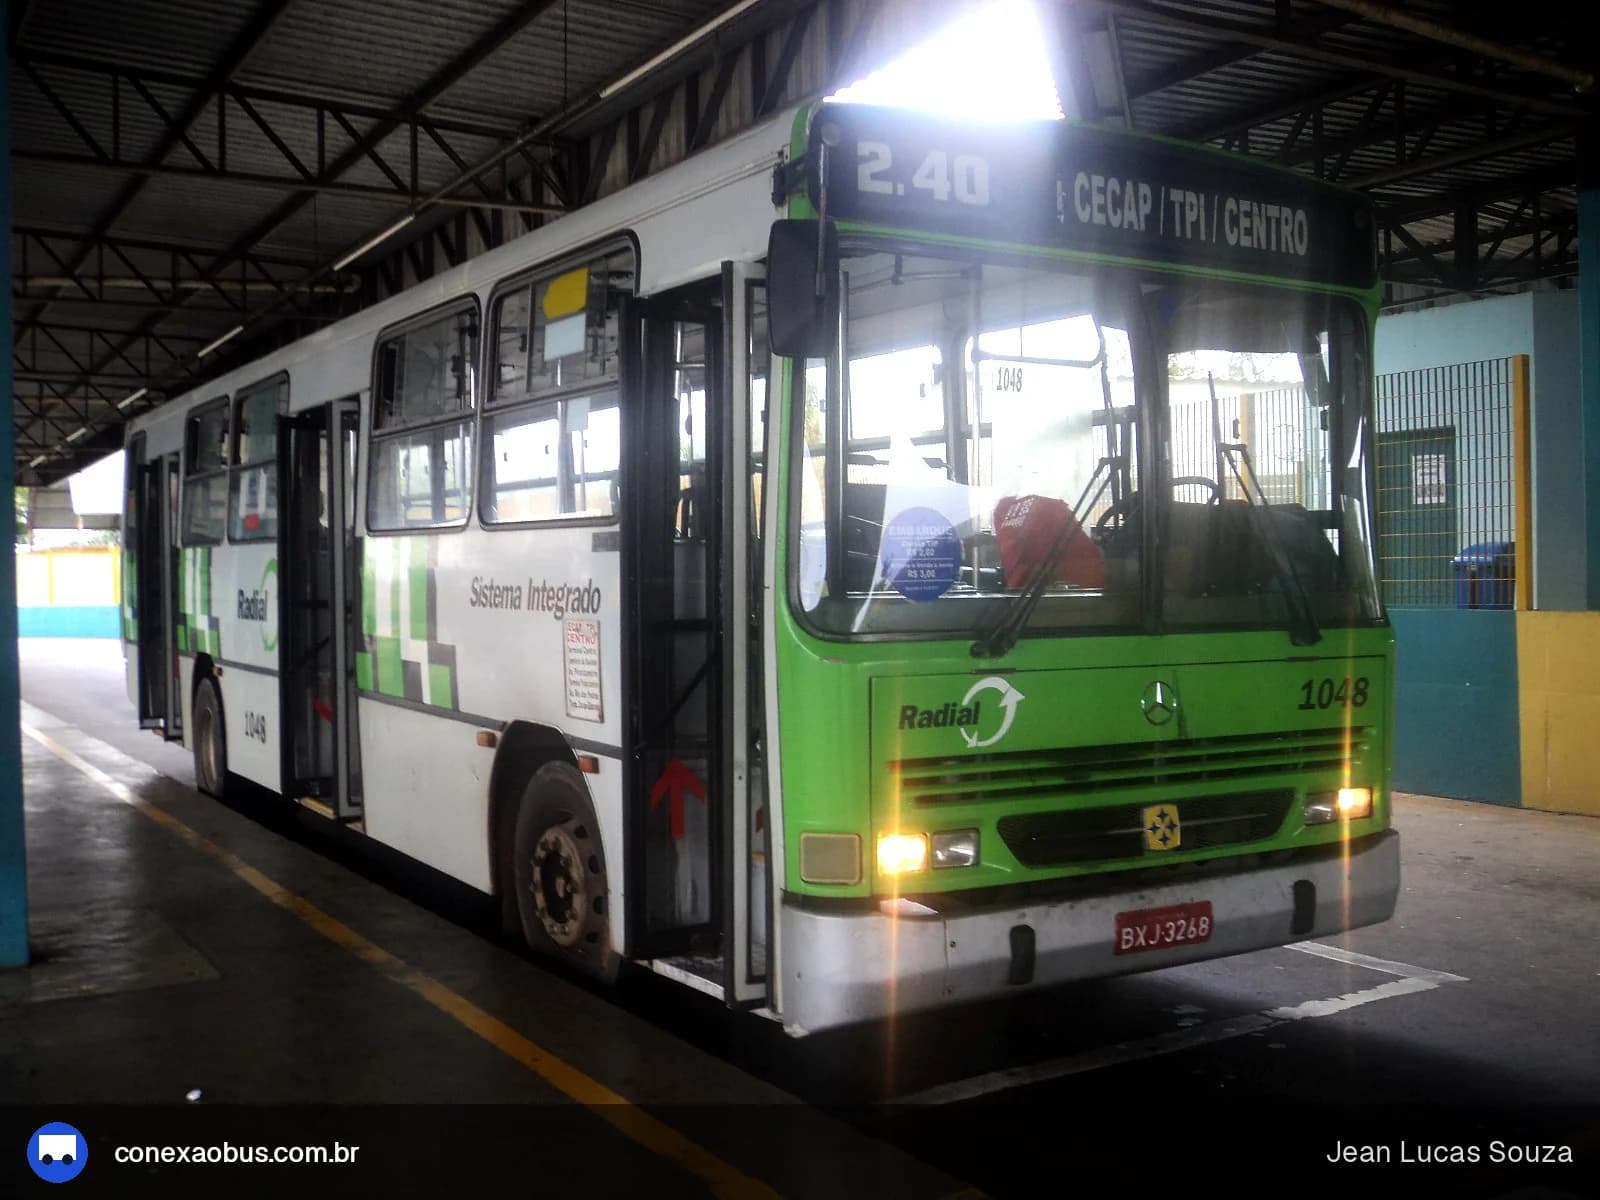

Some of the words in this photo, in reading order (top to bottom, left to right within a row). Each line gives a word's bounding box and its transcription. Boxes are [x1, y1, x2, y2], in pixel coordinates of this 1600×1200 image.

[856, 141, 990, 207] 2.40
[1073, 171, 1152, 233] CECAP
[1169, 188, 1206, 243] TPI
[1223, 197, 1309, 257] CENTRO
[996, 367, 1023, 392] 1048
[237, 588, 268, 622] Radial
[470, 576, 522, 610] Sistema
[527, 578, 601, 620] Integrado
[1297, 677, 1369, 710] 1048
[244, 711, 266, 744] 1048
[898, 701, 981, 730] Radial
